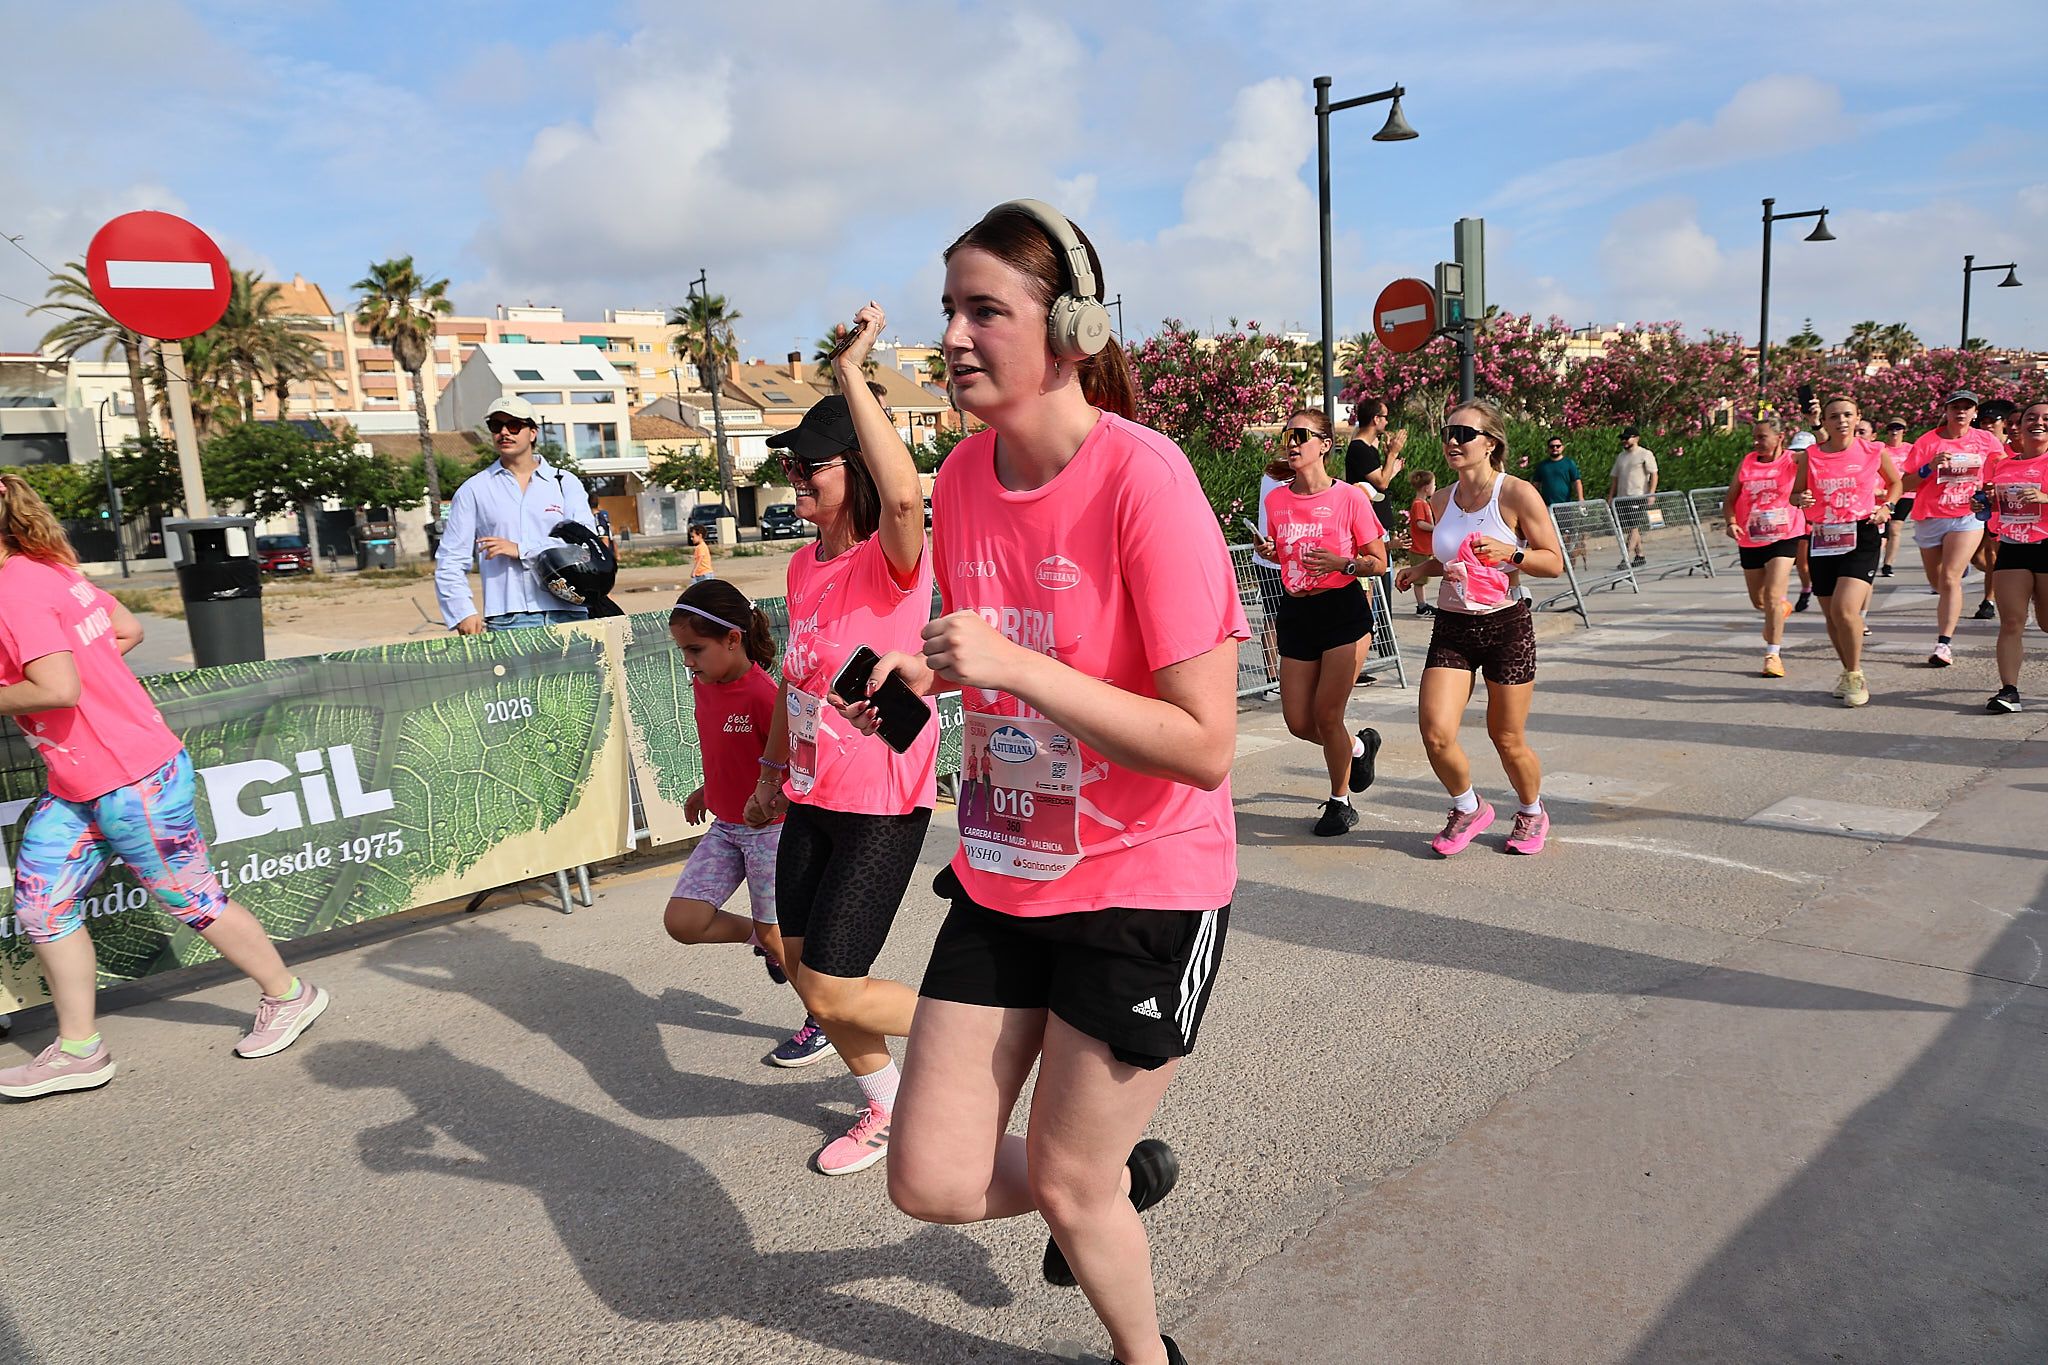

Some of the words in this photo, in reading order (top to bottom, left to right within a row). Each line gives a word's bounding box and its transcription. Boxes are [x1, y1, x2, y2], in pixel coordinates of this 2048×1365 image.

[1277, 522, 1323, 539] CARRERA
[957, 560, 996, 578] OYSHO
[484, 697, 533, 724] 2026
[727, 713, 750, 724] c'est
[991, 736, 1033, 756] ASTURIANA
[993, 787, 1035, 818] 016
[1006, 820, 1020, 833] 360
[963, 826, 992, 841] CARRERA
[992, 832, 1001, 841] DE
[1008, 836, 1027, 847] MUJER
[1031, 839, 1063, 853] VALENCIA
[238, 841, 332, 886] desde
[337, 828, 404, 864] 1975
[1022, 858, 1067, 873] Santander
[1131, 1005, 1162, 1020] adidas
